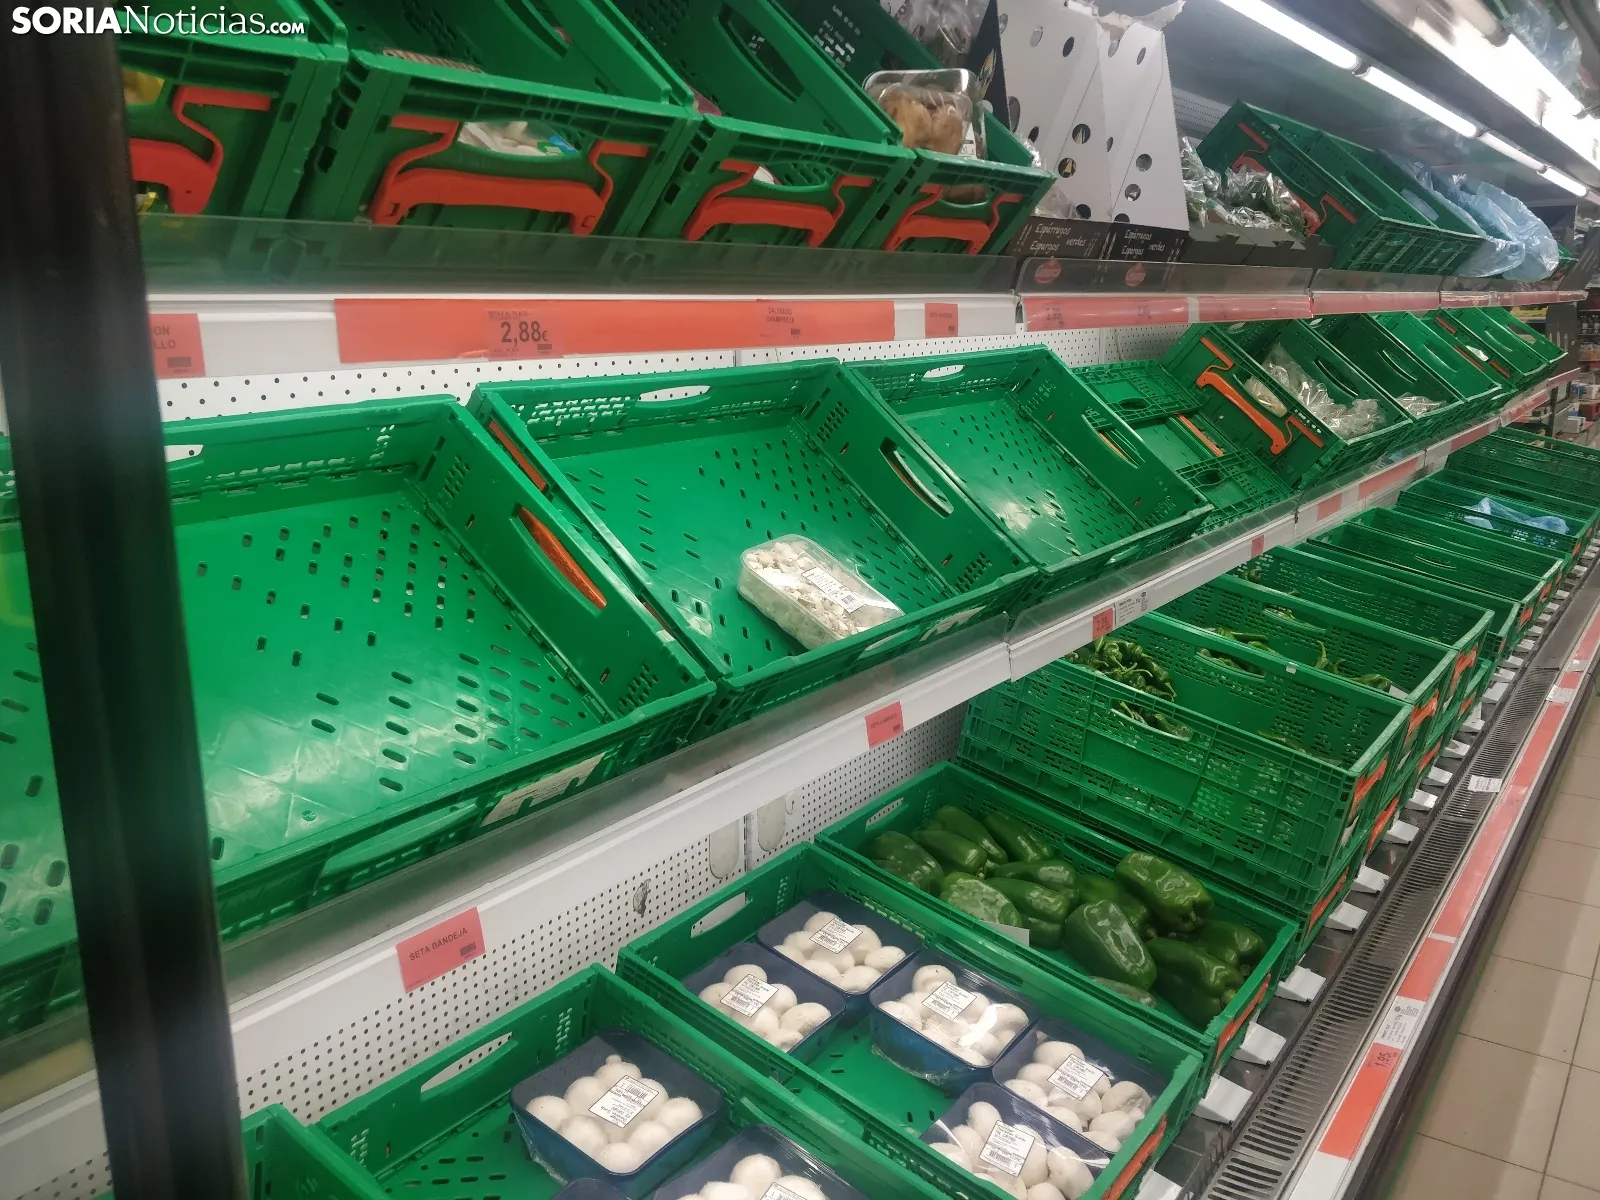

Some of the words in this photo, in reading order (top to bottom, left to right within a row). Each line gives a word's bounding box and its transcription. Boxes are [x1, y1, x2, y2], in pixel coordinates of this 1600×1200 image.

[1066, 235, 1087, 246] verdes
[1149, 241, 1166, 252] verdes
[500, 320, 549, 347] 2,88€
[409, 945, 431, 961] SETA
[431, 927, 468, 950] BANDEJA
